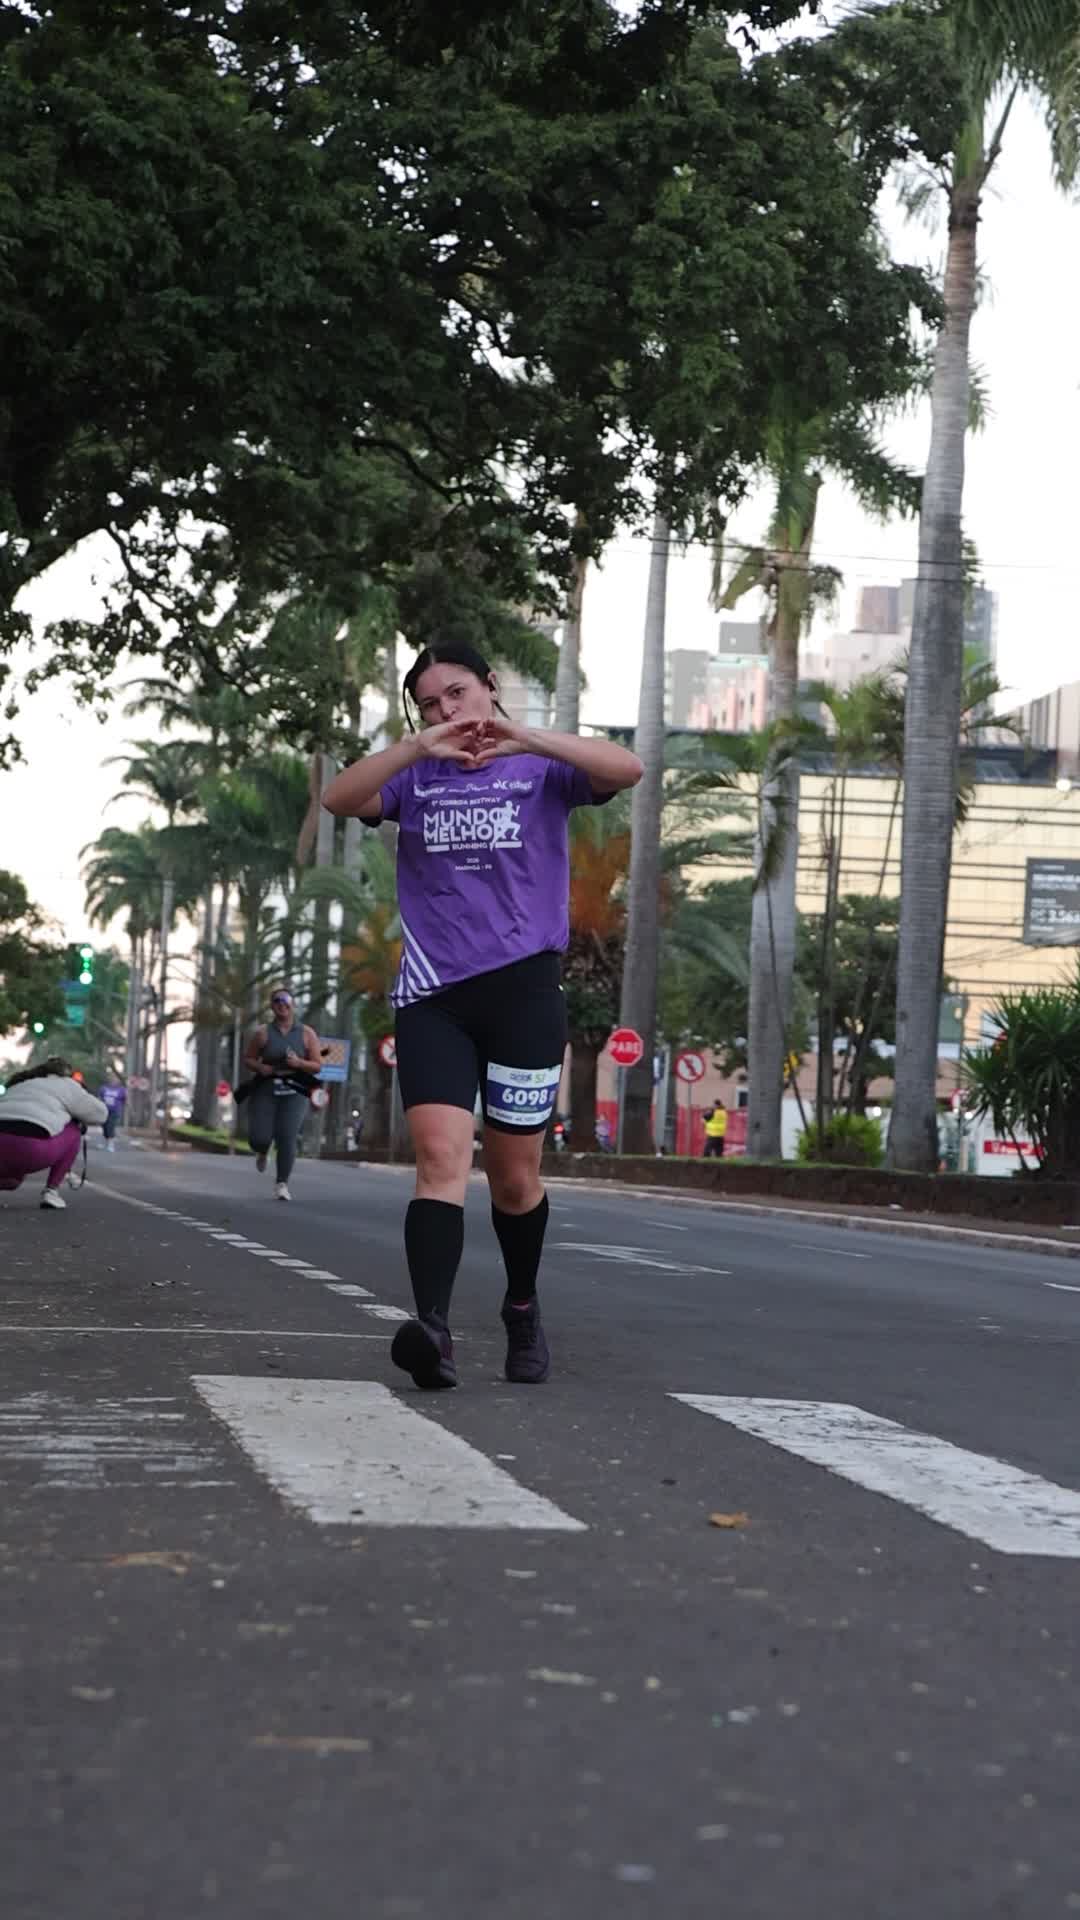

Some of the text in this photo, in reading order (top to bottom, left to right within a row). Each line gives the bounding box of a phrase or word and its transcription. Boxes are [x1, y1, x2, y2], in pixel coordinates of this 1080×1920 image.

[424, 808, 508, 832] MUNDO
[424, 824, 506, 843] MELHOR
[452, 842, 488, 850] RUNNING
[610, 1041, 640, 1054] PARE
[502, 1087, 549, 1106] 6098
